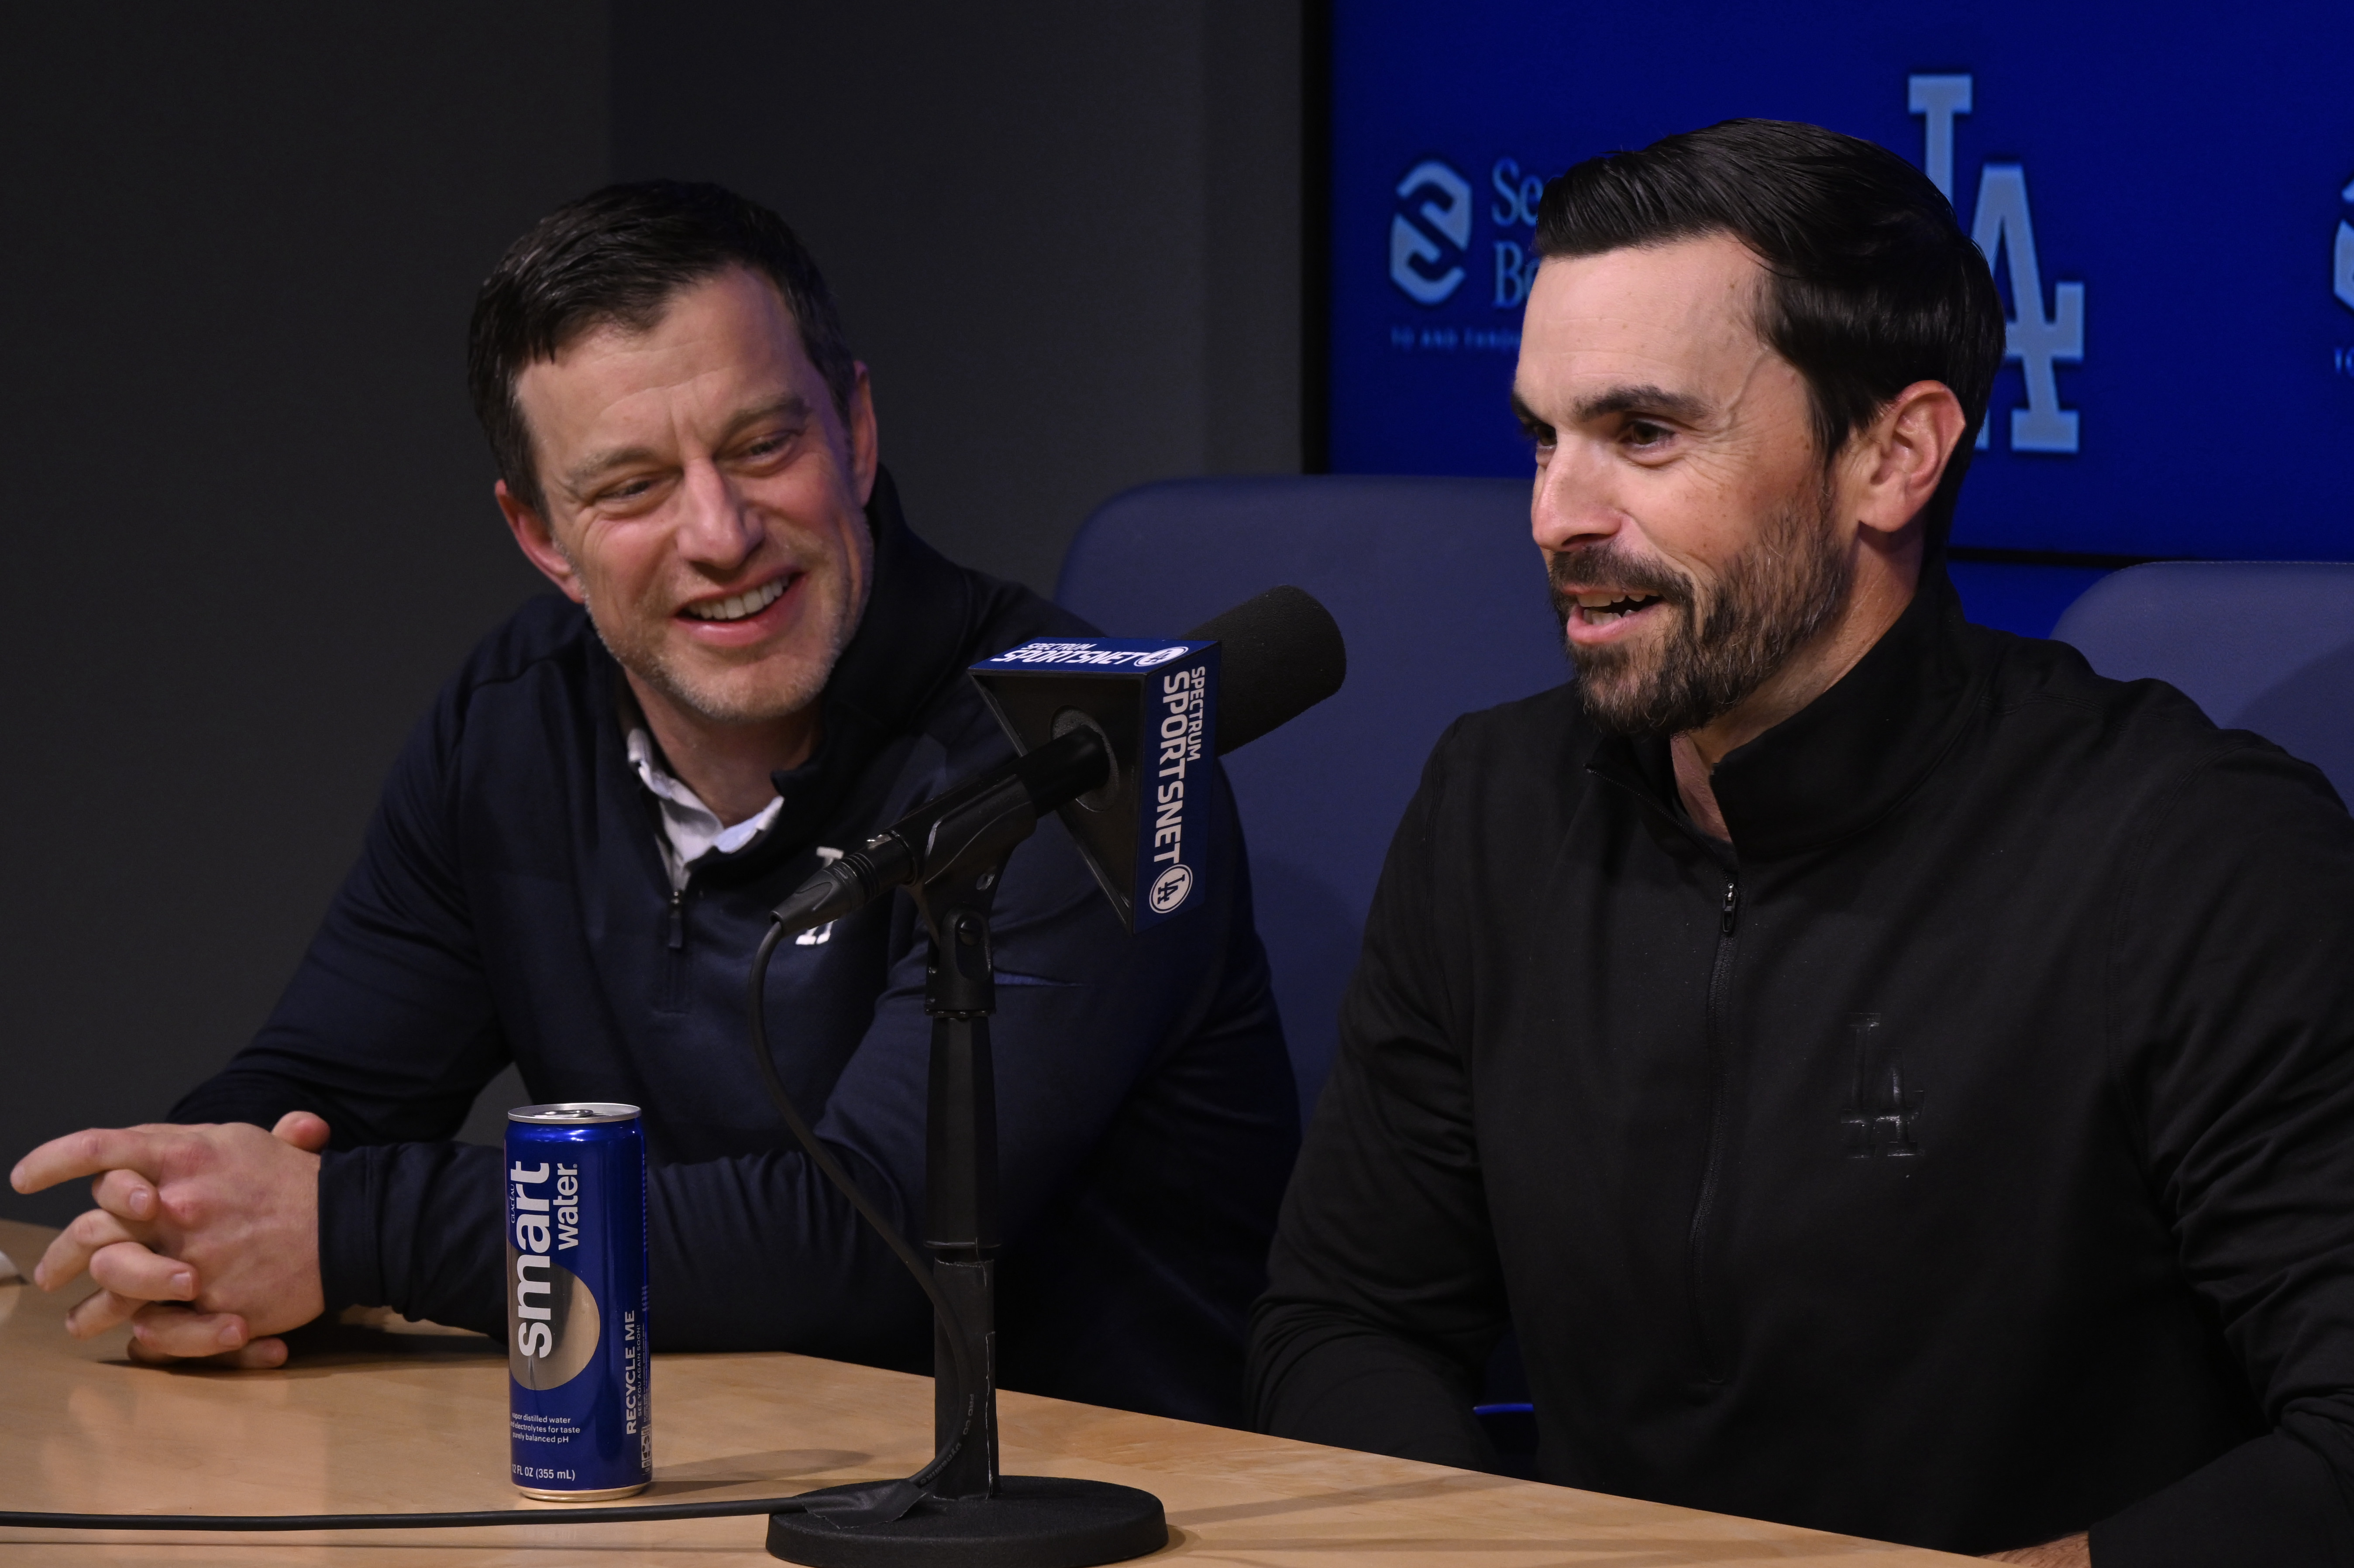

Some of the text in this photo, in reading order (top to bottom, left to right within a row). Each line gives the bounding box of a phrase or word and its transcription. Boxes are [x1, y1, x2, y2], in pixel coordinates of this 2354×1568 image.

[990, 650, 1151, 664] SPORTSNET
[1187, 666, 1205, 761] SPECTRUM
[1154, 671, 1190, 864] SPORTSNET
[1841, 1012, 1924, 1159] LA
[510, 1161, 552, 1358] smart
[625, 1310, 637, 1434] RECYCLE ME
[523, 1414, 547, 1423] distilled
[515, 1422, 547, 1433] electrolytes
[963, 1420, 971, 1435] CO
[513, 1432, 569, 1444] purely balanced pH
[512, 1464, 575, 1481] 12 FL OZ (355 mL)
